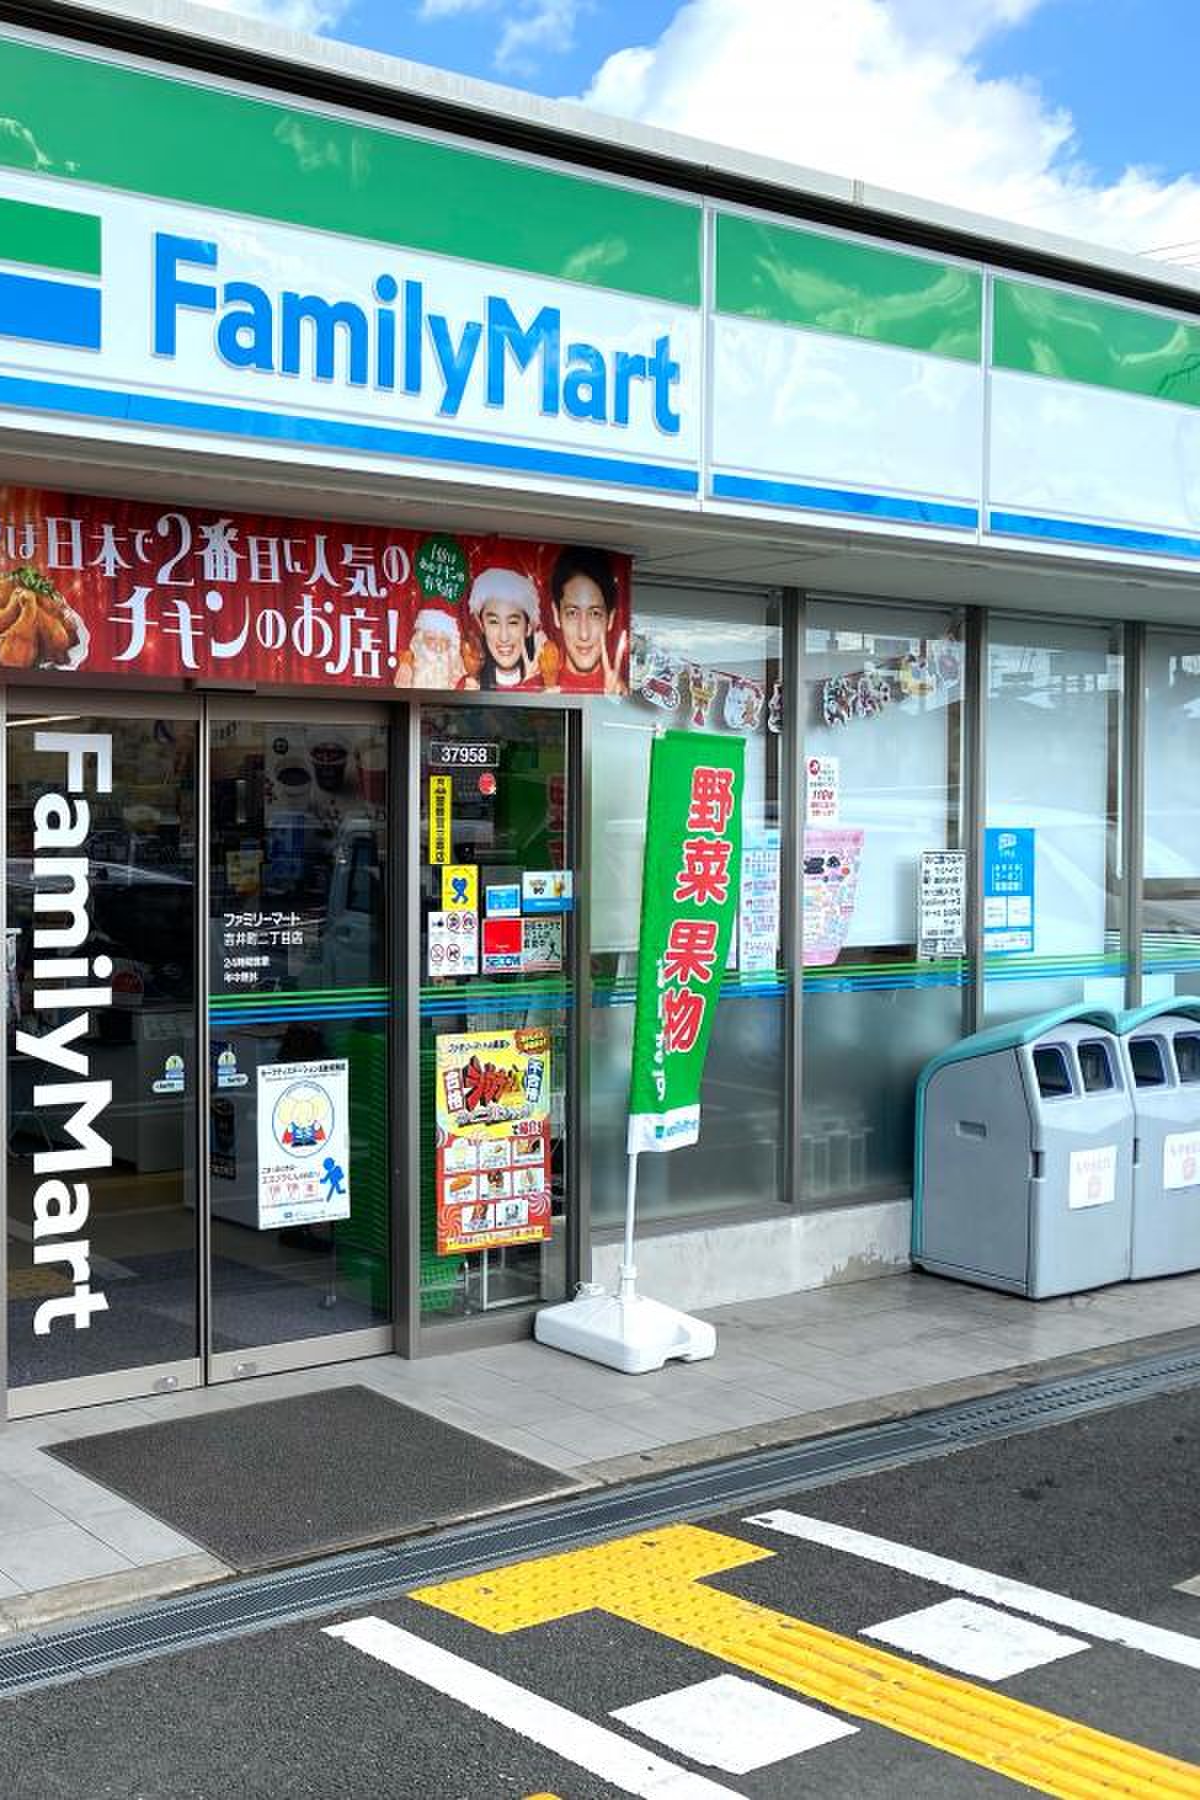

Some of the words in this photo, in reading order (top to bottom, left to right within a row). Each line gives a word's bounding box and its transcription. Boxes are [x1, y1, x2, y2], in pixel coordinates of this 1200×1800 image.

[153, 231, 681, 434] FamilyMart
[108, 585, 398, 679] チキンのお店!
[441, 747, 488, 764] 37958
[673, 766, 734, 906] 野菜
[223, 911, 301, 928] ファミリーマート
[662, 918, 719, 1054] 果物
[15, 732, 113, 1335] FamilyMart
